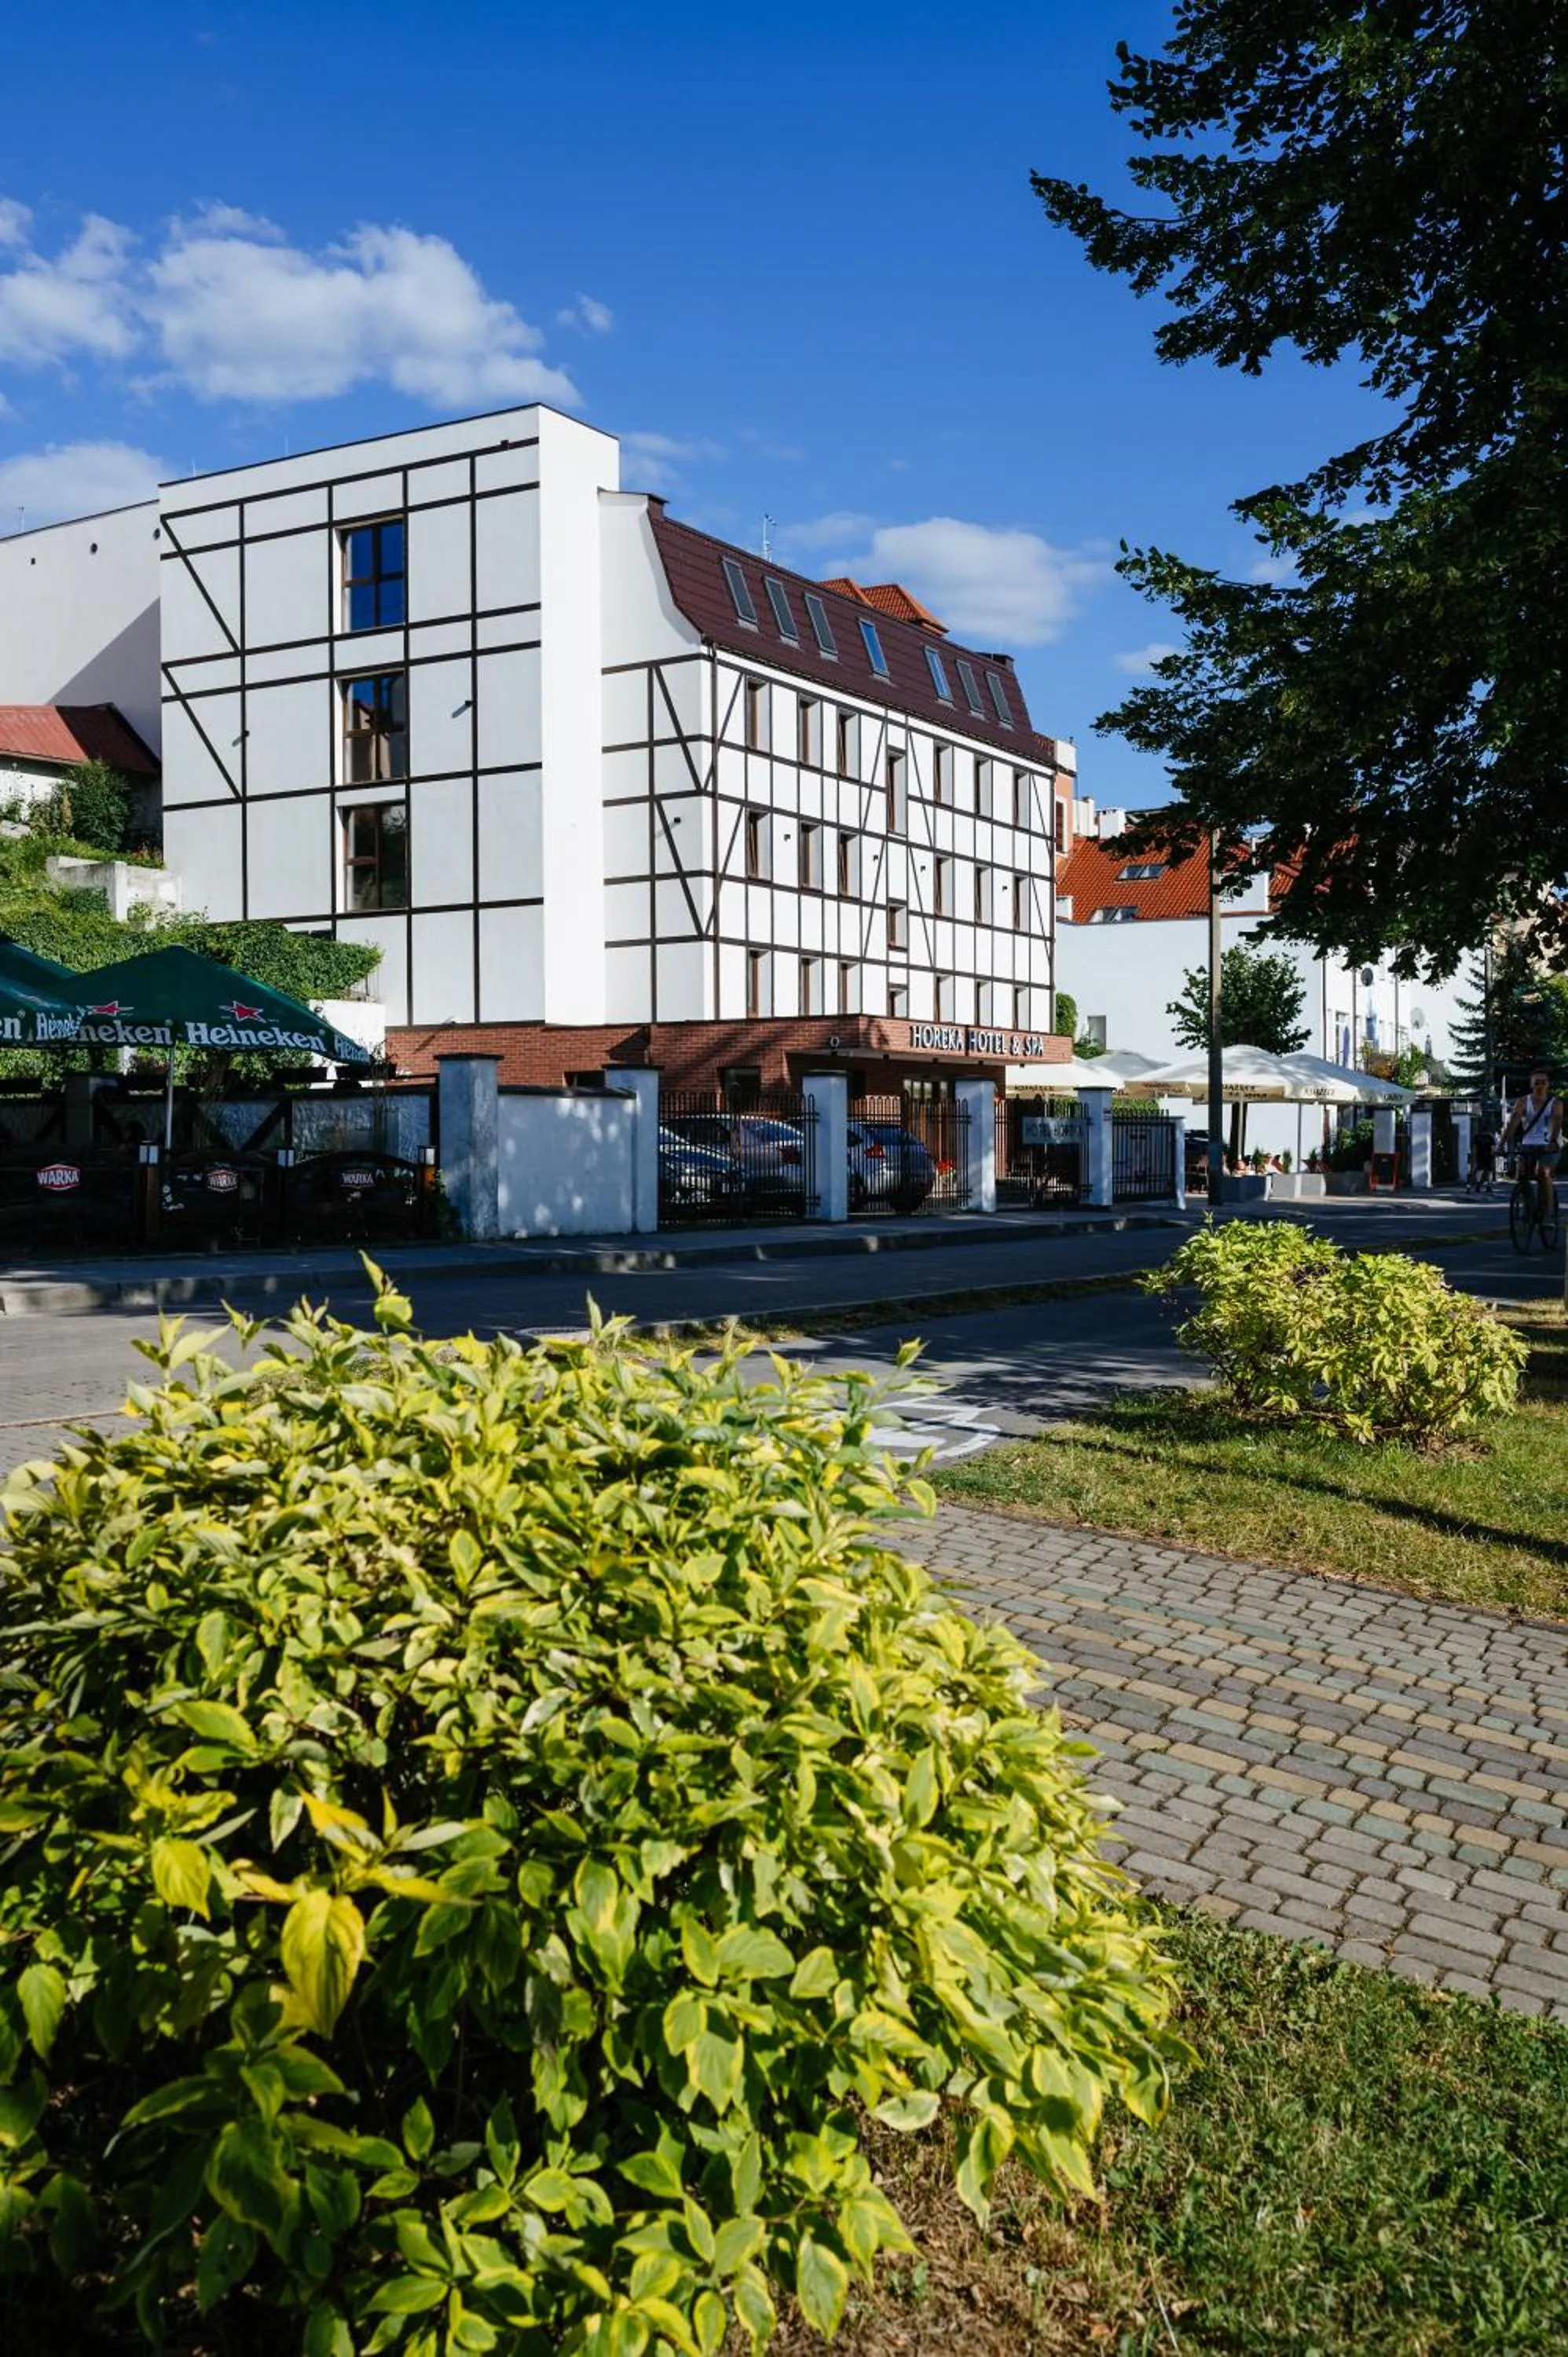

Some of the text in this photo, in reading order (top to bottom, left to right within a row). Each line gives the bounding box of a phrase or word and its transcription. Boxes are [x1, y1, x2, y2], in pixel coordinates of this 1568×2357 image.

[185, 1021, 327, 1051] Heineken
[910, 1025, 1044, 1057] HOREKA HOTEL & SPA
